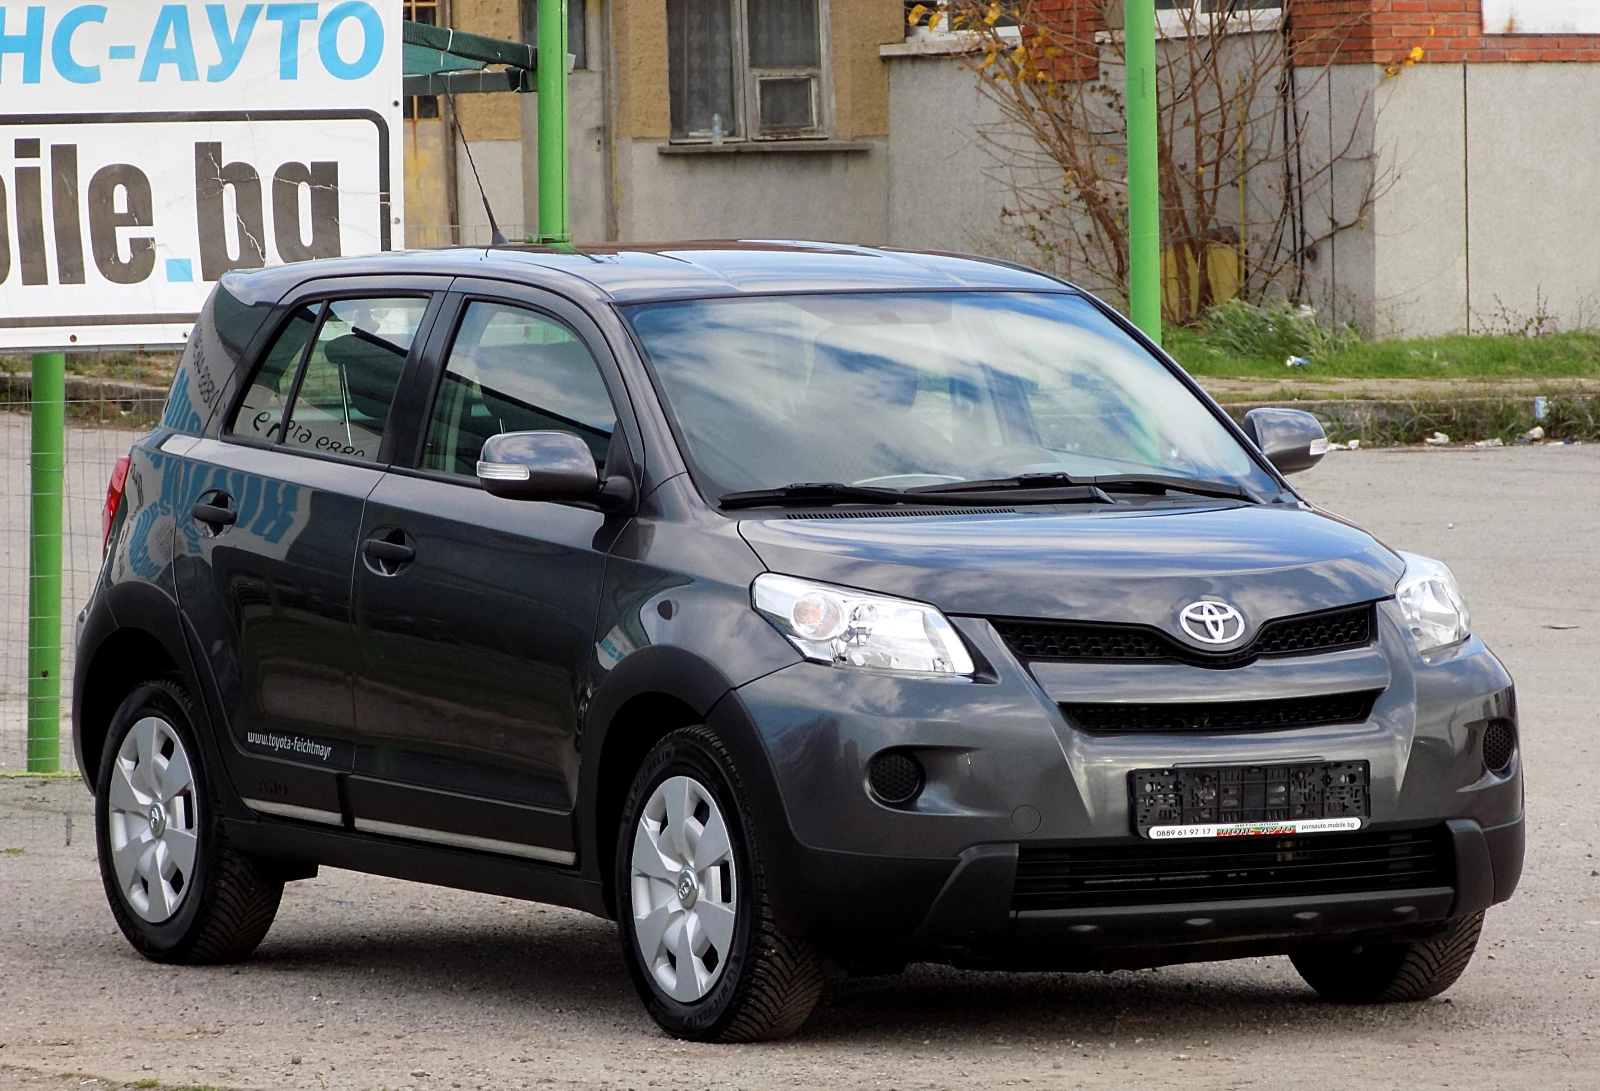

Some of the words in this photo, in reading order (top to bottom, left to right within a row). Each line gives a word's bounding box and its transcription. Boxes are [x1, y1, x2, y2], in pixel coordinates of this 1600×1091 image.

[0, 138, 341, 286] ile.bg
[247, 731, 332, 760] www.toyota-feichtmayr
[1301, 821, 1355, 830] ponsauto.mobile.bg
